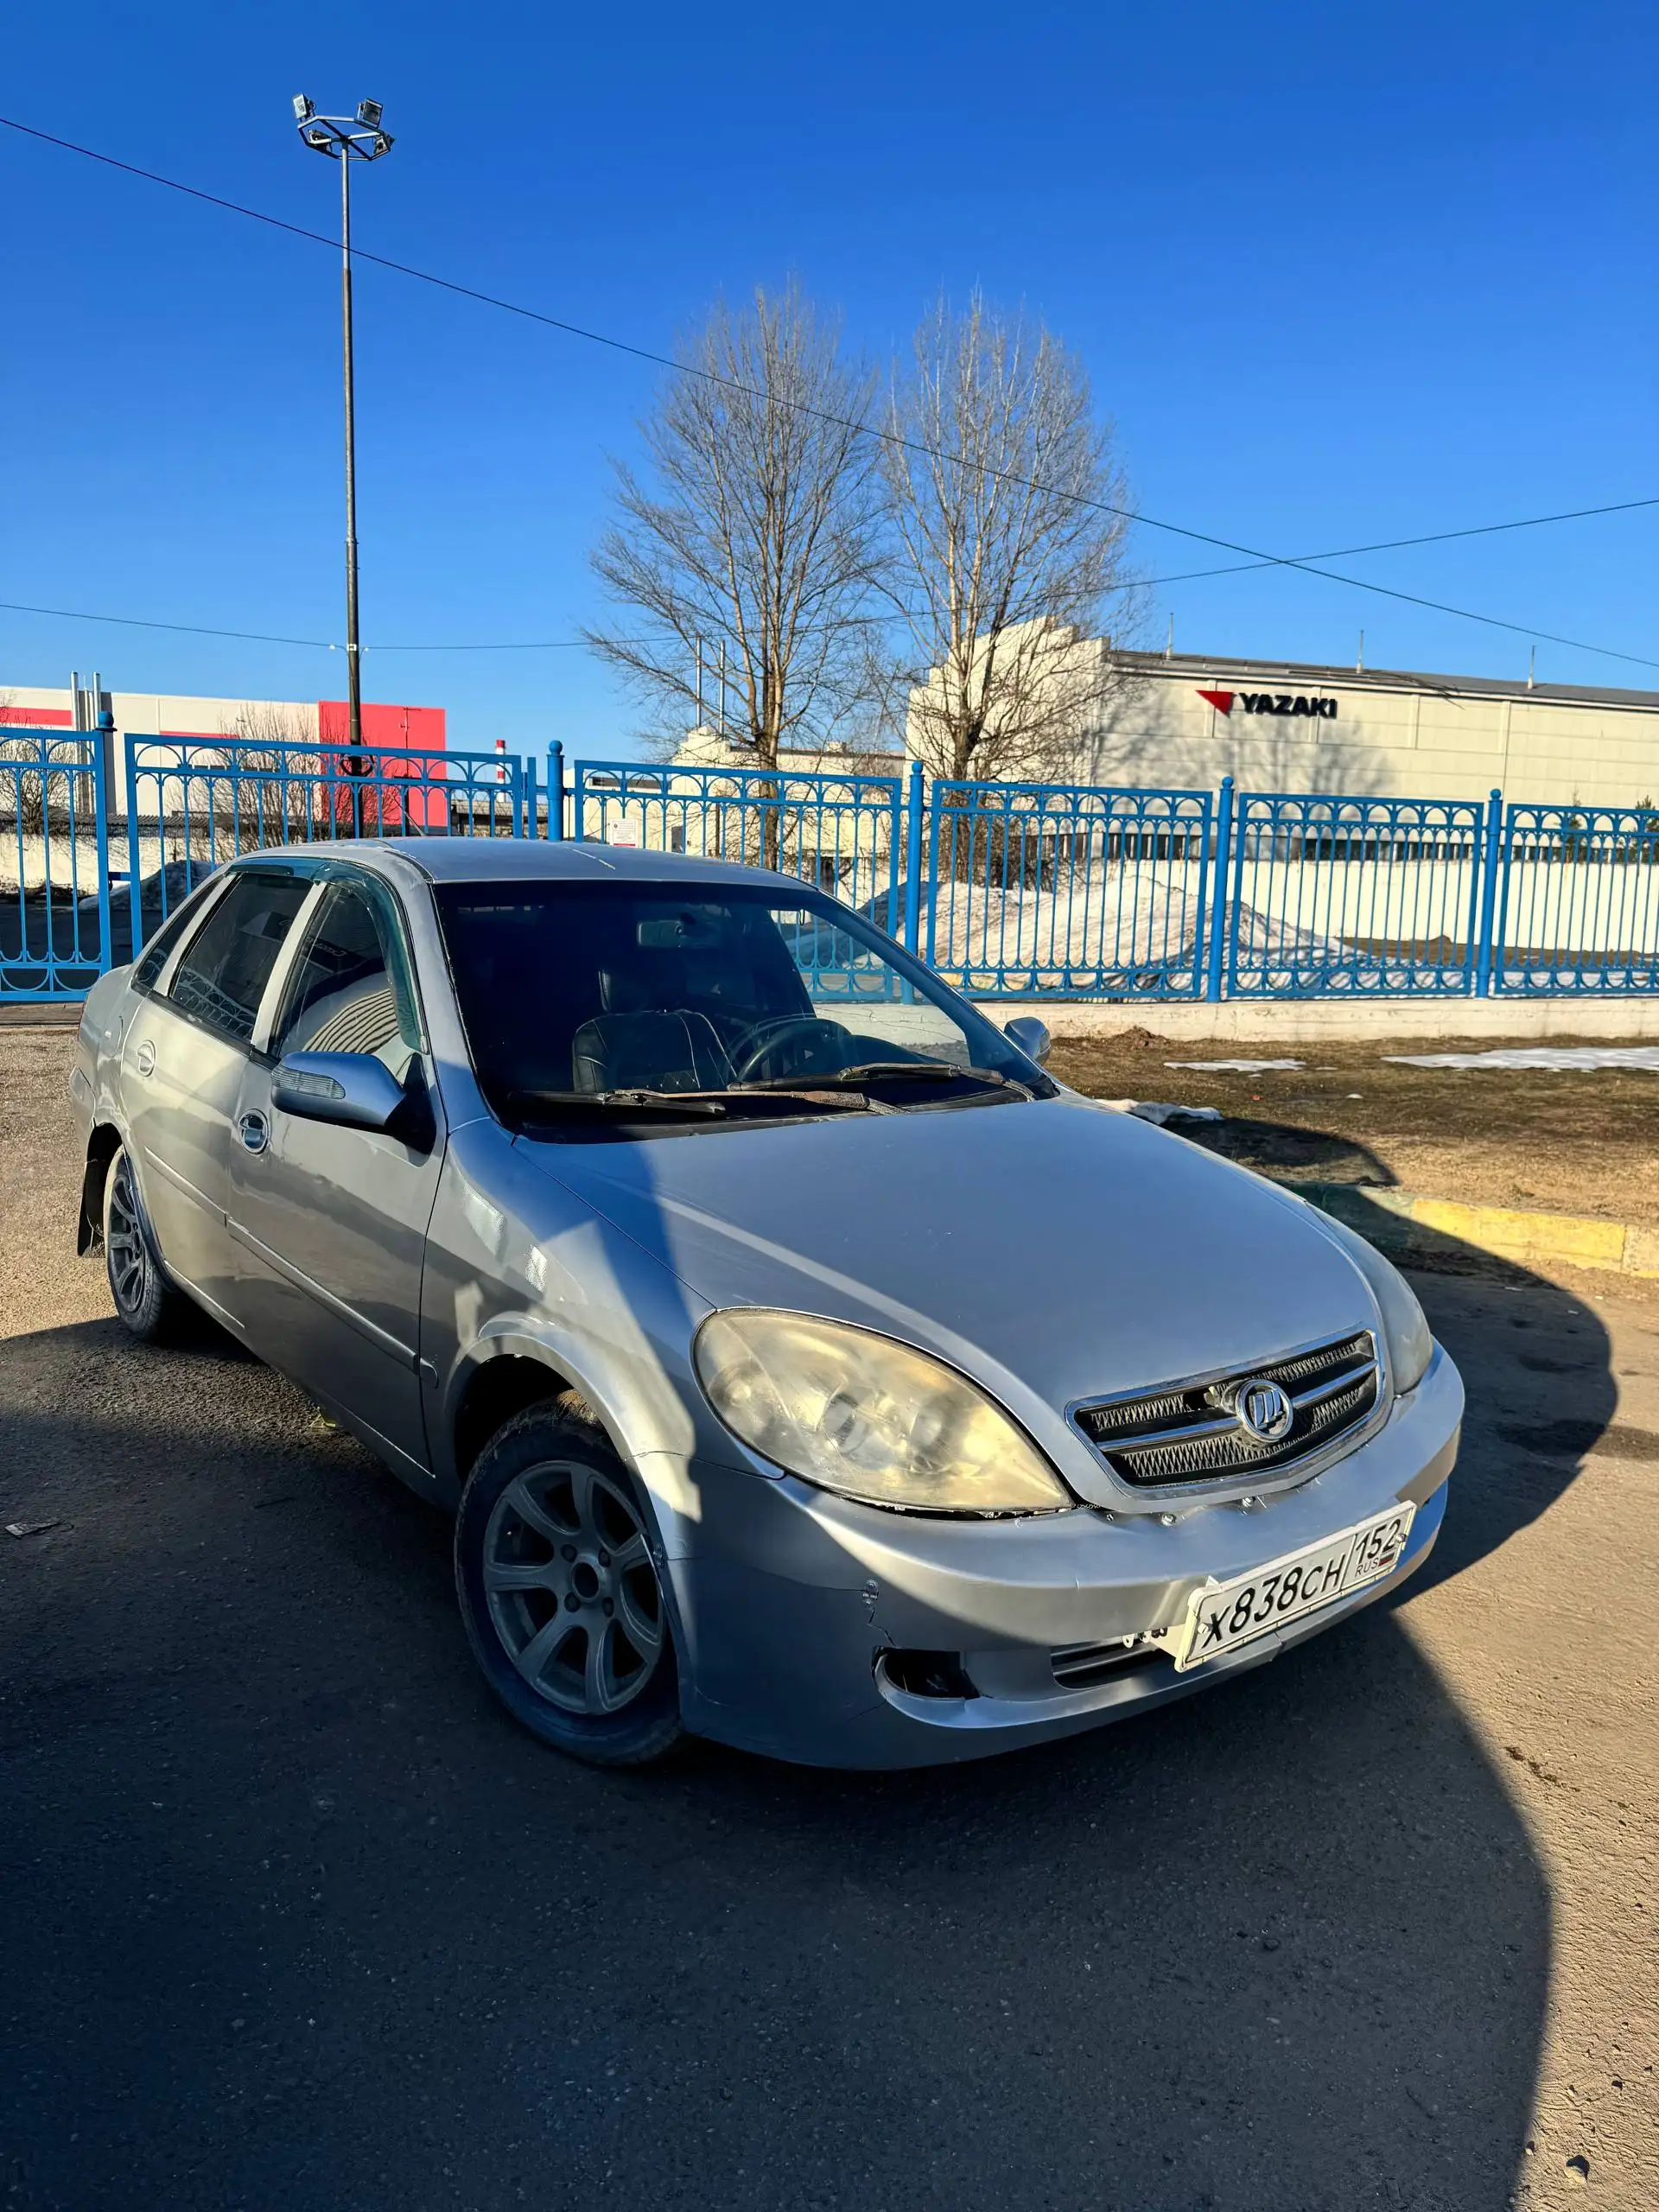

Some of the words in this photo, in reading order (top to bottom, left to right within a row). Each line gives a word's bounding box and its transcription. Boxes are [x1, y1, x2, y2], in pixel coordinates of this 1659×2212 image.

[1238, 692, 1338, 719] YAZAKI
[1355, 1518, 1401, 1565] 152
[1354, 1556, 1380, 1579] RUS
